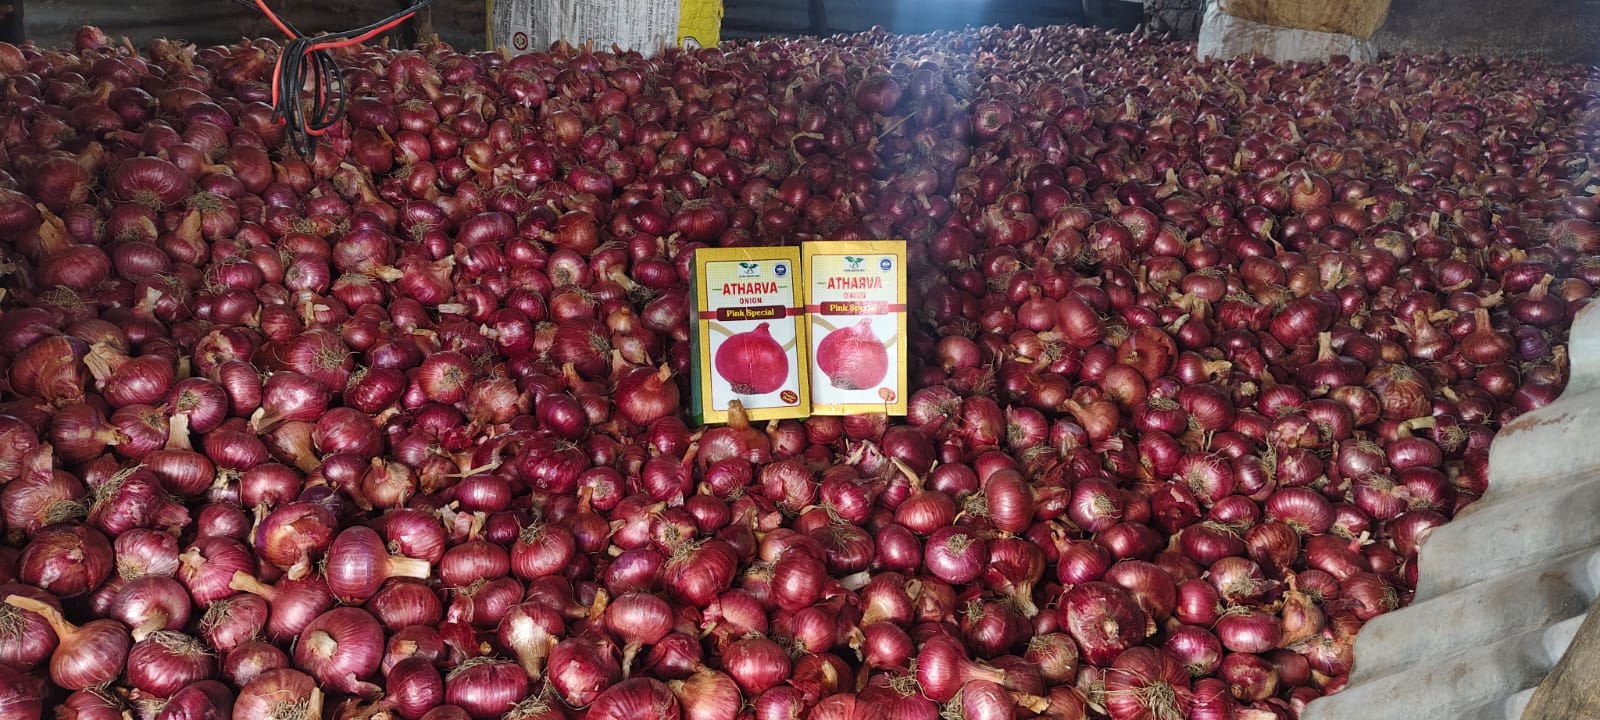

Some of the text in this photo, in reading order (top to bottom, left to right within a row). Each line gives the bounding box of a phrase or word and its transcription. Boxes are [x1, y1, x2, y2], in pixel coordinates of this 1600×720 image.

[827, 277, 882, 289] ATHARVA
[723, 282, 778, 295] ATHARVA
[726, 308, 775, 317] Pink Special
[829, 304, 848, 312] Pink
